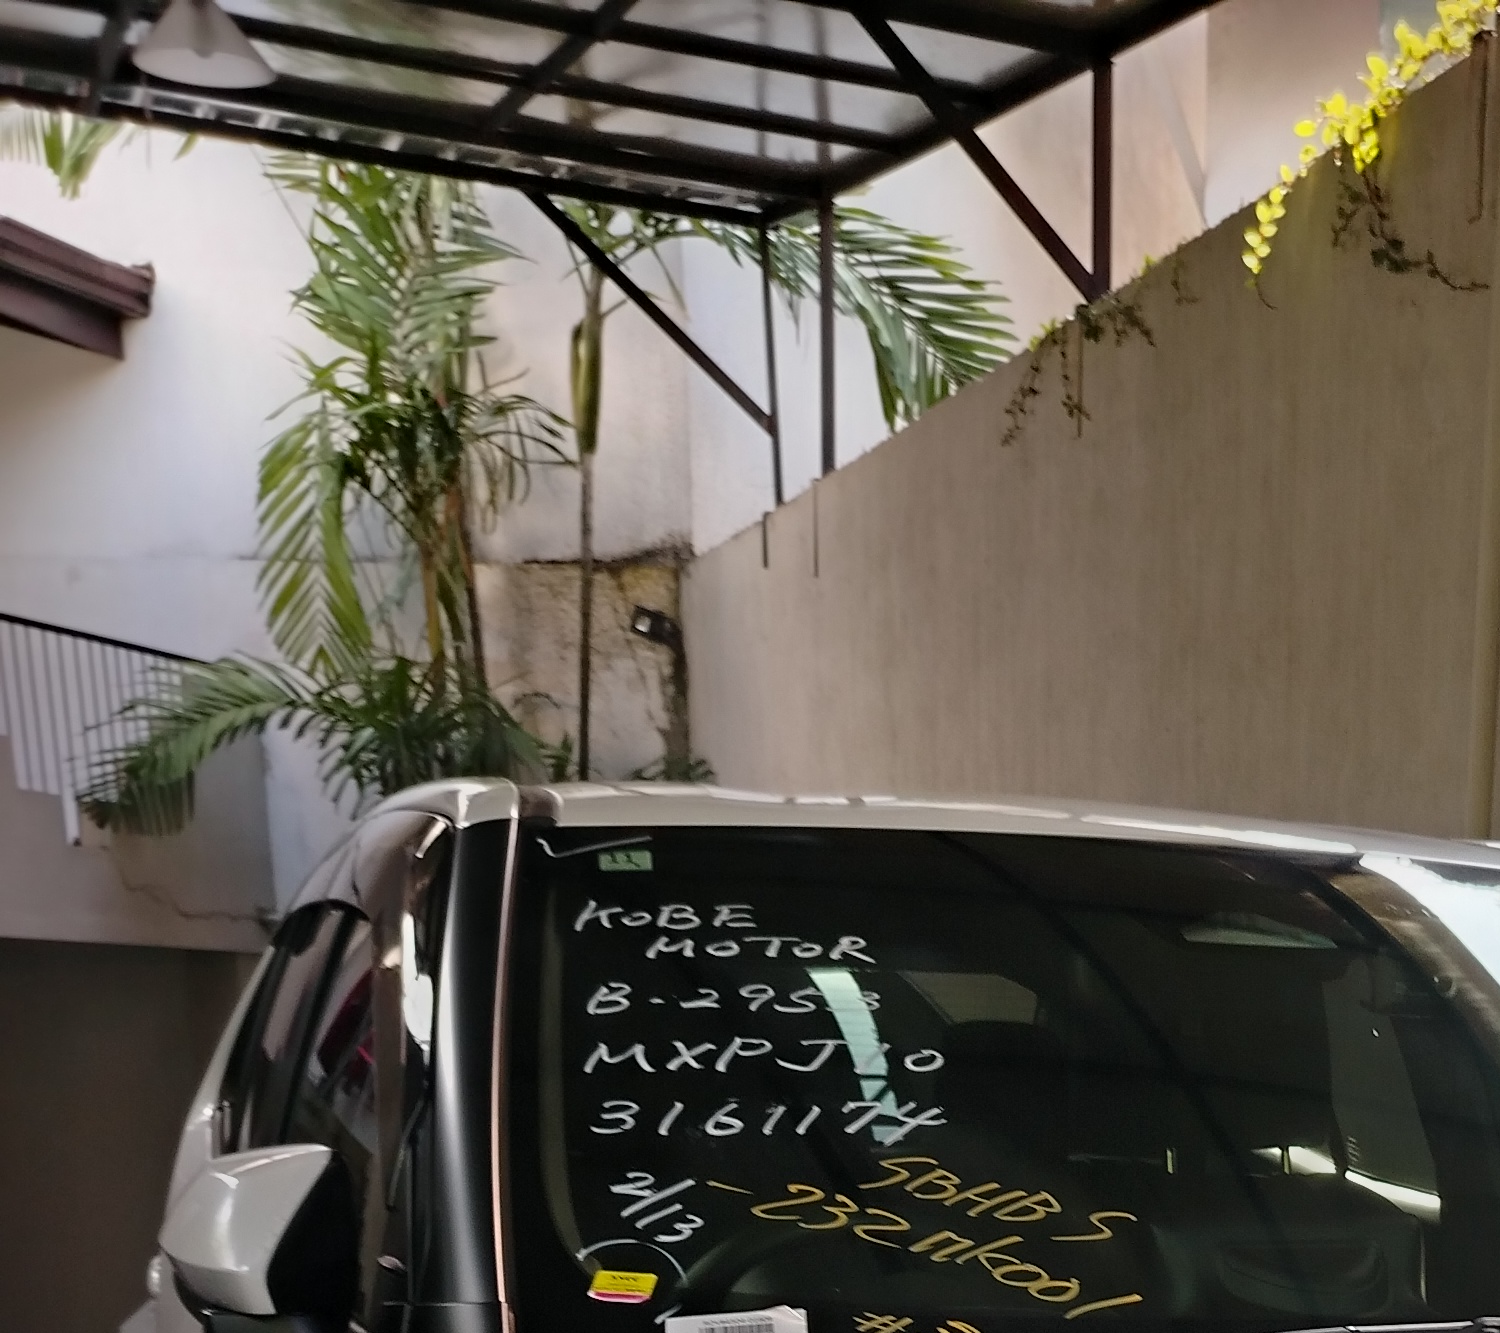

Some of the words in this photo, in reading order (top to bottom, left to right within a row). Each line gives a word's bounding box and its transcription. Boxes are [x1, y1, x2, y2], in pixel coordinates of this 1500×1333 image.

[574, 900, 757, 932] KOBE
[645, 935, 877, 964] MOTOR
[583, 1036, 946, 1074] MXPJ10
[589, 1100, 948, 1146] 3161174
